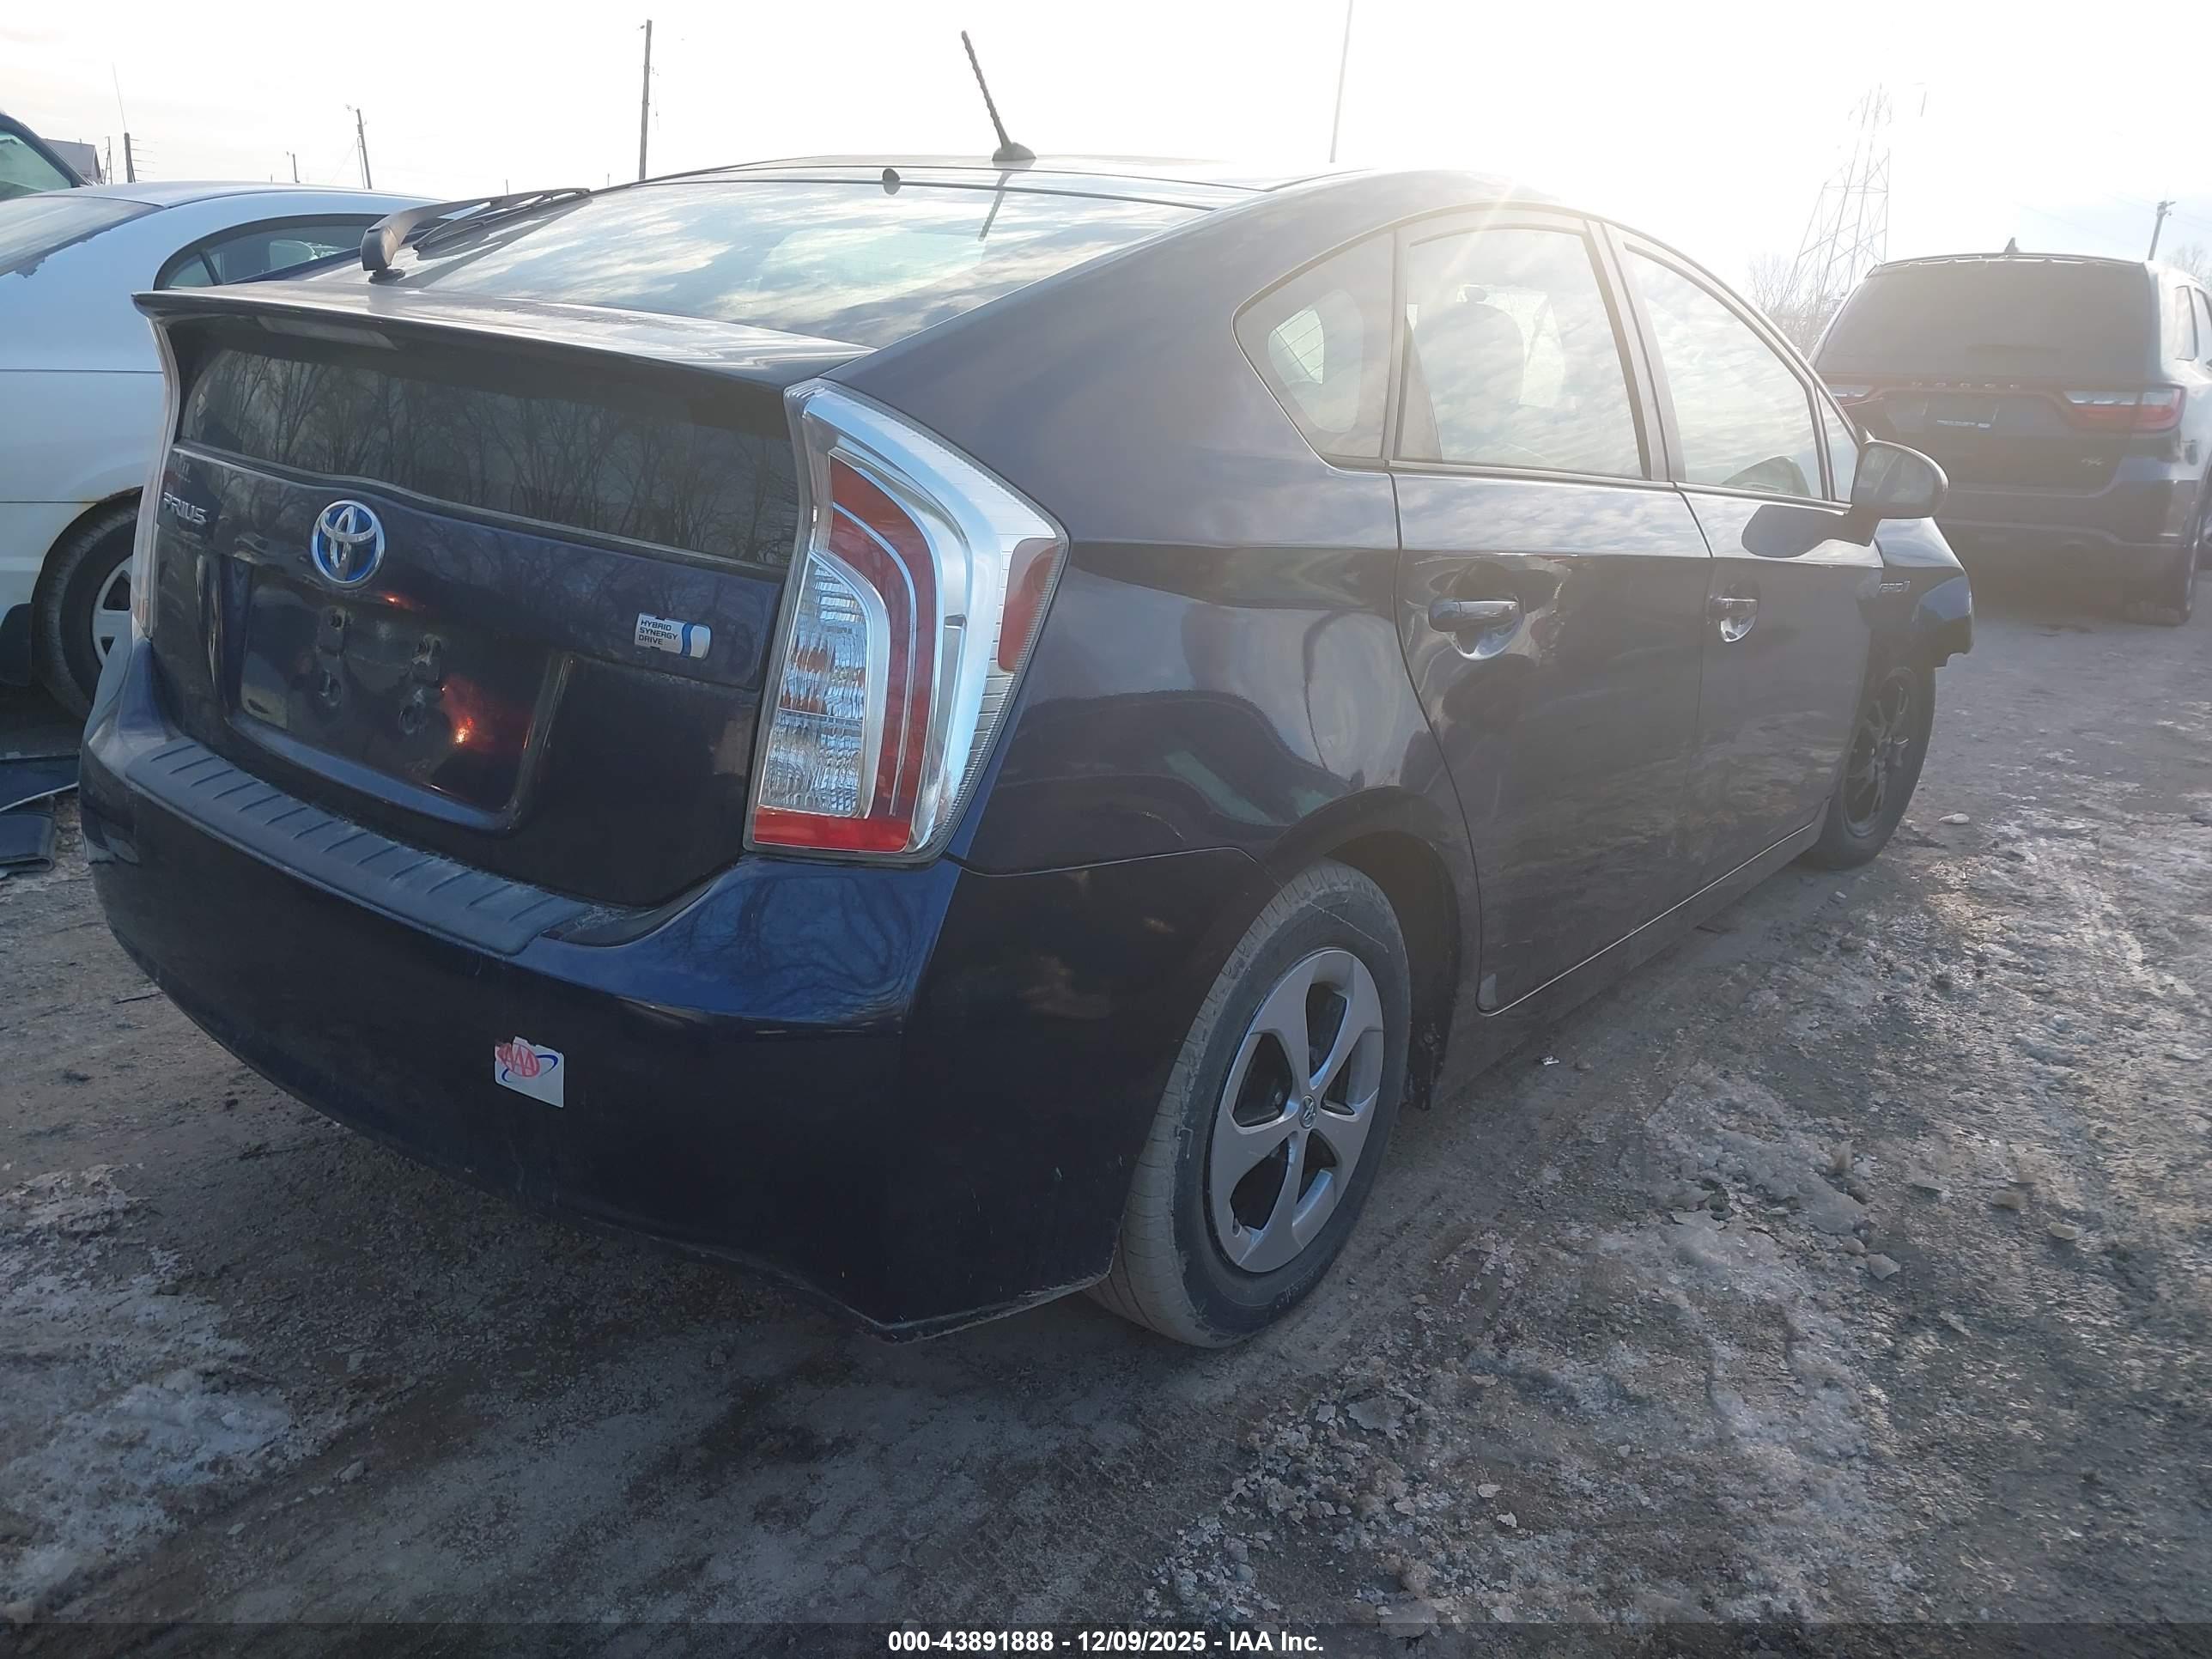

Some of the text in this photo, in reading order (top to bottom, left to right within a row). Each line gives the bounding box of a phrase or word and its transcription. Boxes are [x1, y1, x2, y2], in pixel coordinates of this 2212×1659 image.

[163, 491, 207, 526] PRIUS
[641, 619, 672, 631] HYBRID
[638, 635, 664, 646] DRIVE
[639, 627, 678, 641] SYNERGY
[501, 1042, 539, 1077] AAA
